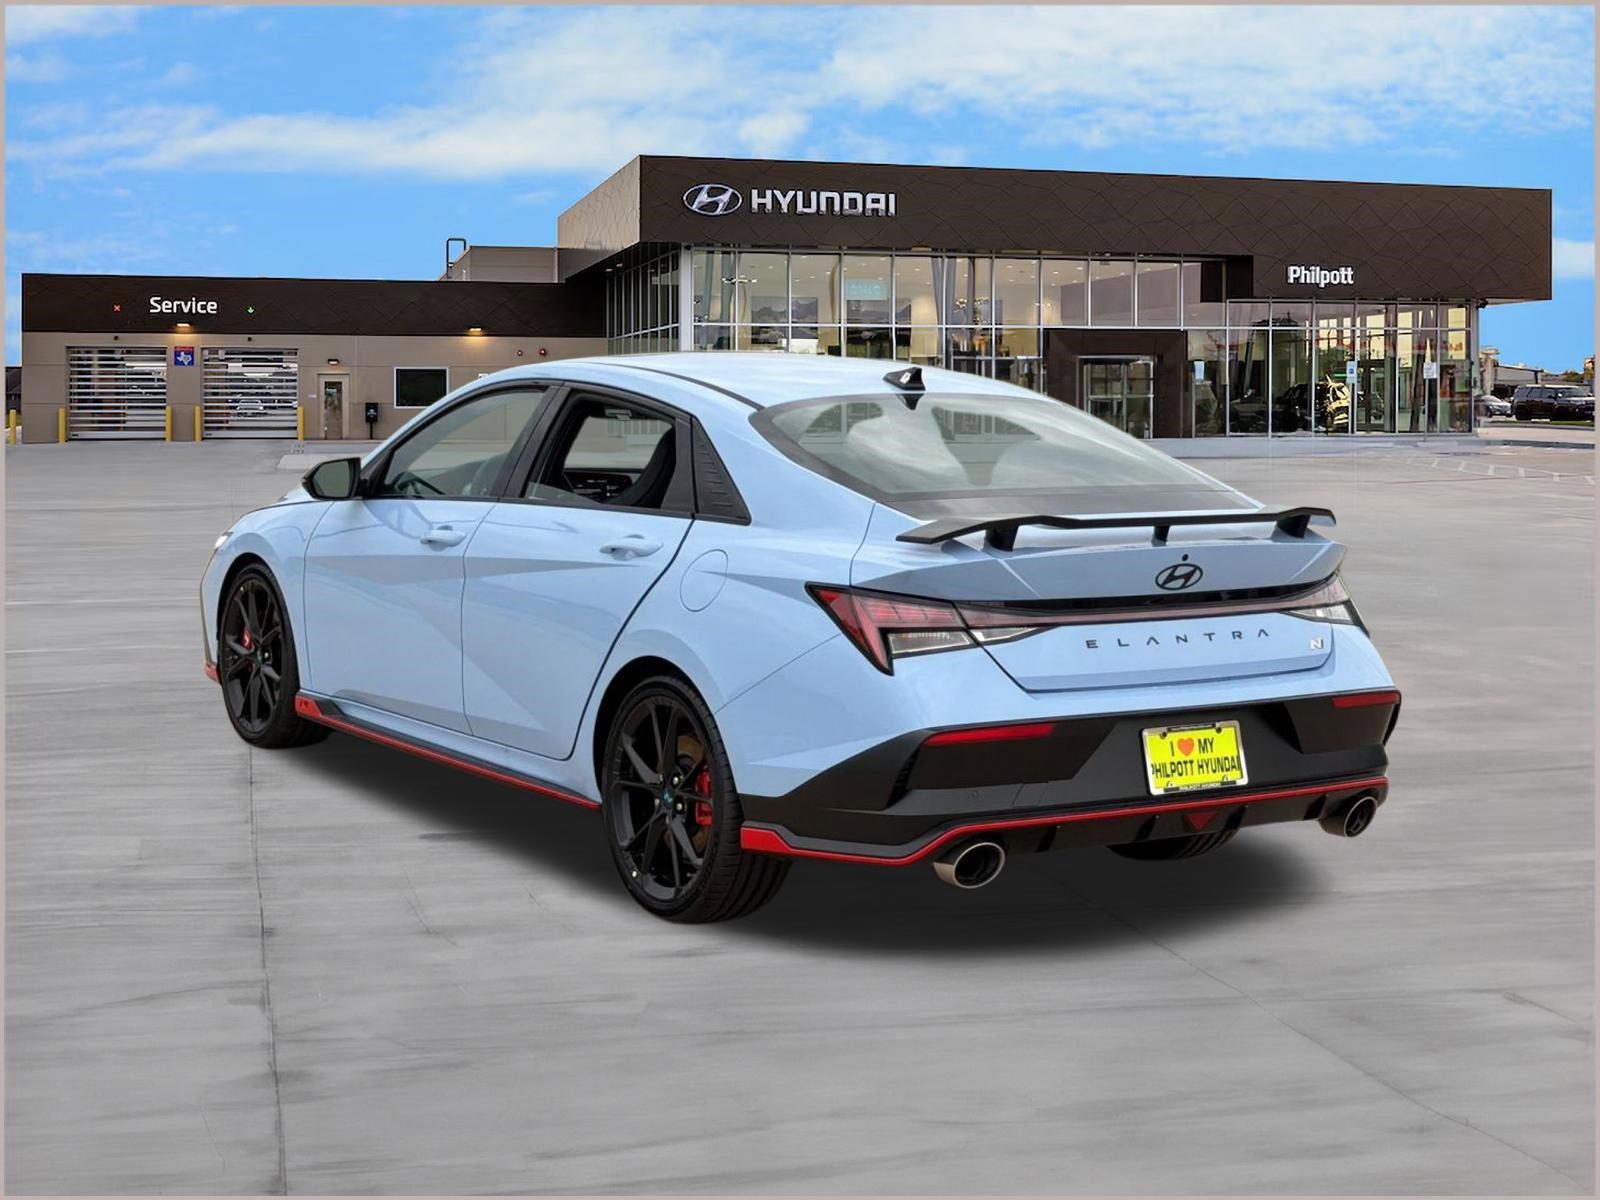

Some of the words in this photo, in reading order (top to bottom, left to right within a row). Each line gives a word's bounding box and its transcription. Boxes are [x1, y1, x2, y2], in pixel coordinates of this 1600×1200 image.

[751, 188, 896, 217] HYUNDAI
[1287, 265, 1355, 288] Philpott
[149, 296, 218, 314] Service
[1085, 627, 1270, 650] ELANTRA
[1169, 740, 1175, 757] I
[1197, 737, 1215, 754] MY
